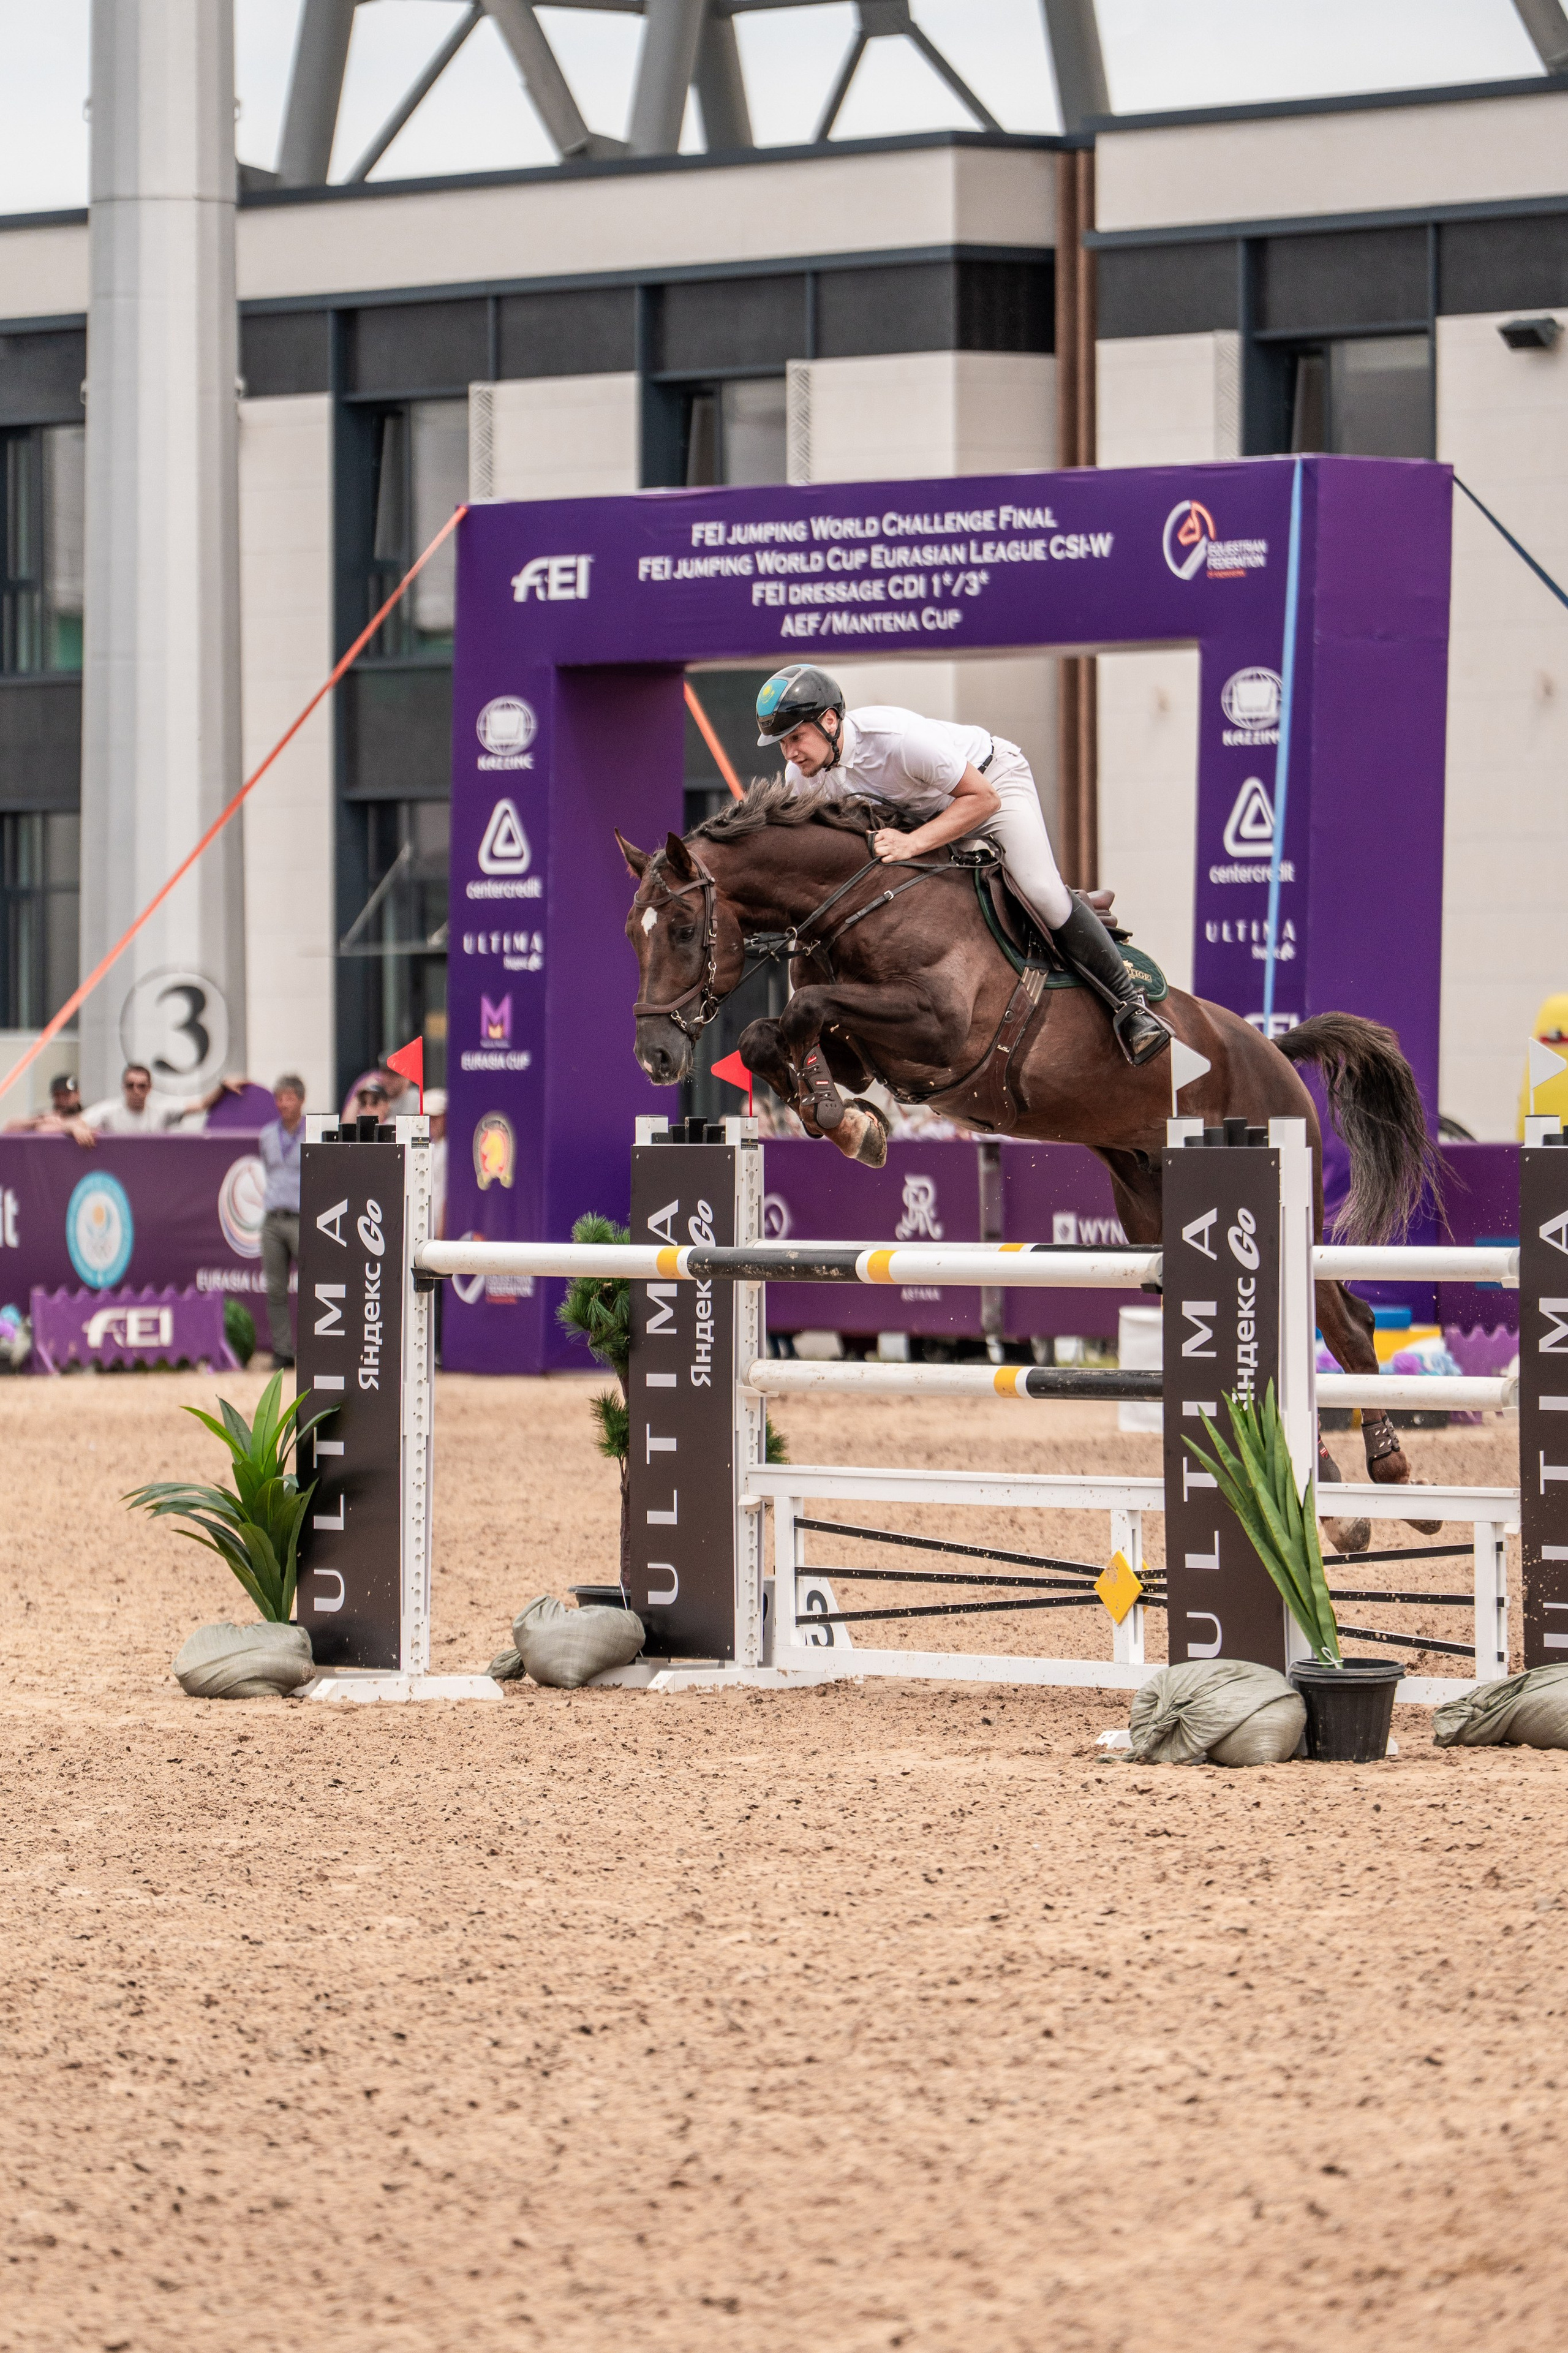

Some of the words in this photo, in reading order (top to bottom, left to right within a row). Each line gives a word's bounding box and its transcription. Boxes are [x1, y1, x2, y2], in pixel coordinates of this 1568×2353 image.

[692, 521, 726, 547] FEI
[727, 520, 809, 545] JUMPING
[810, 516, 880, 540] WORLD
[882, 510, 997, 536] CHALLENGE
[998, 505, 1058, 531] FINAL
[638, 555, 672, 581] FEI
[673, 554, 754, 580] JUMPING
[755, 550, 825, 575] WORLD
[826, 546, 869, 572] CUP
[870, 543, 968, 569] EURASIAN
[970, 538, 1049, 564] LEAGUE
[752, 581, 787, 606] FEI
[788, 578, 886, 605] DRESSAGE
[888, 573, 928, 600] CDI
[921, 606, 963, 631] CUP
[463, 931, 543, 955] ULTIMA
[153, 984, 210, 1075] 3
[357, 1199, 385, 1257] Go
[1227, 1207, 1261, 1271] Go
[83, 1305, 173, 1348] FEI
[358, 1262, 383, 1391] Яндекс
[690, 1279, 715, 1388] Яндек
[313, 1198, 348, 1612] ULTIMA
[645, 1199, 680, 1606] ULTIMA
[1182, 1207, 1223, 1658] ULTIMA
